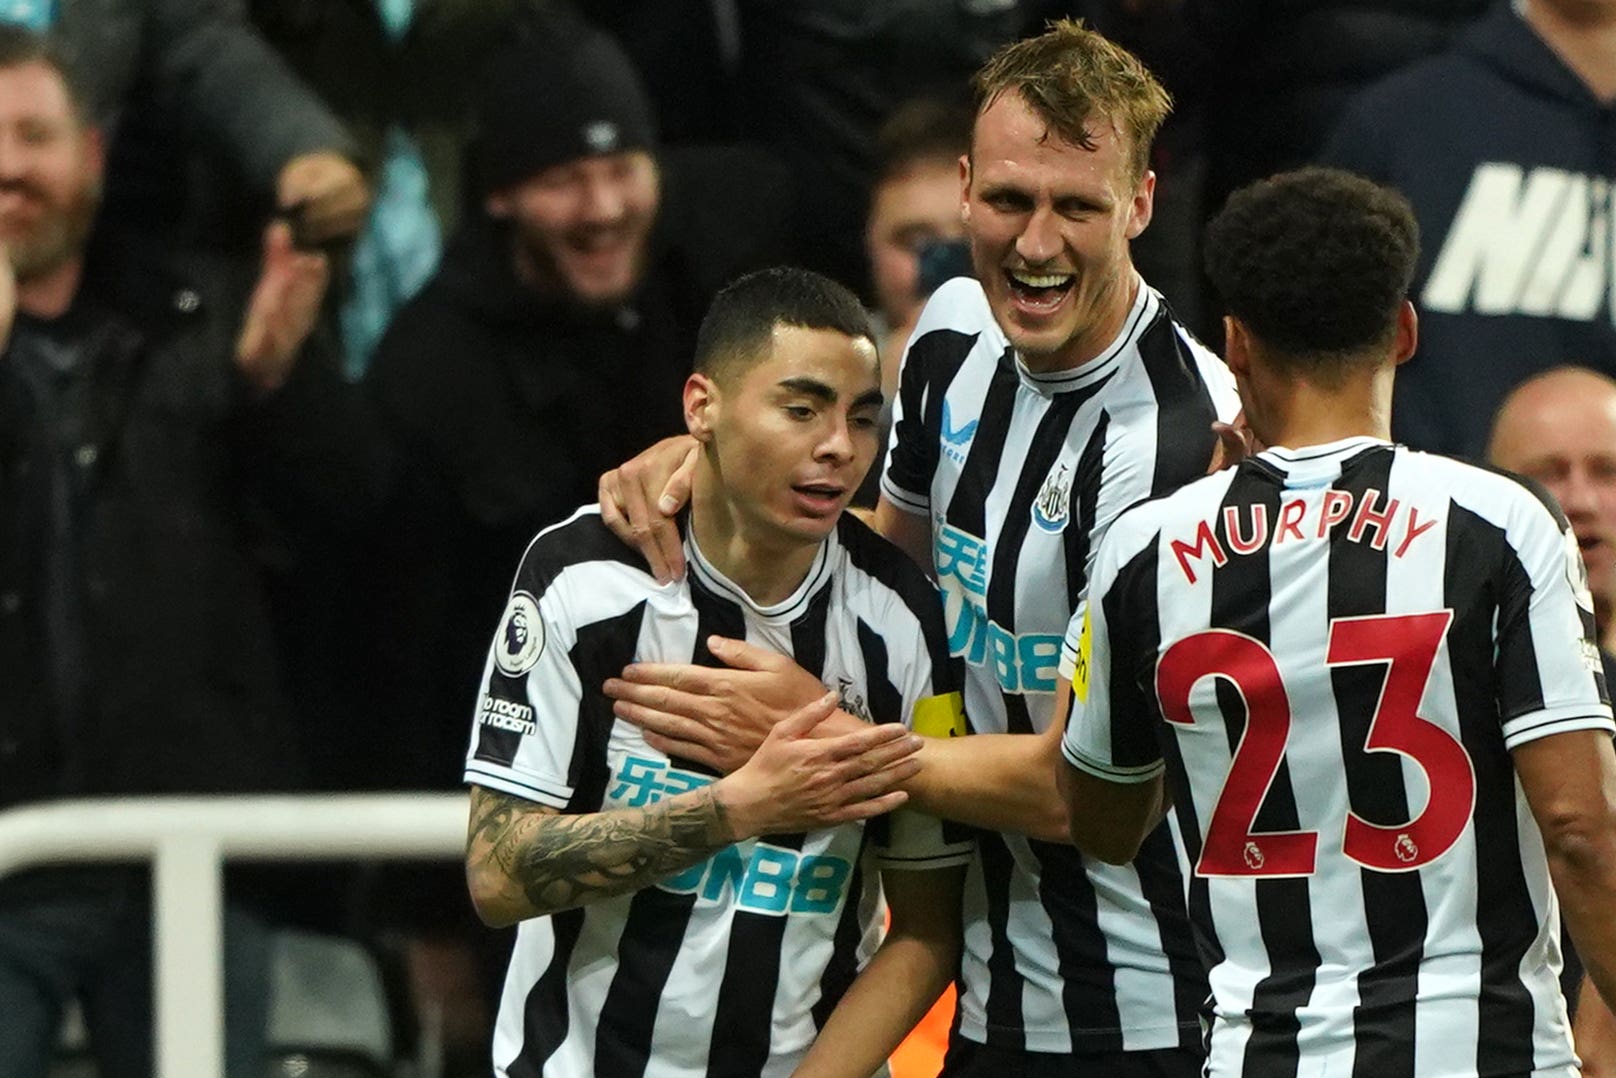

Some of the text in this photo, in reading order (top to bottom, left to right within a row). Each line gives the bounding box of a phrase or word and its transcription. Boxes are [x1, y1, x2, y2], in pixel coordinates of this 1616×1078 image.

[1169, 488, 1438, 585] MURPHY
[492, 699, 533, 721] room
[1154, 608, 1477, 879] 23
